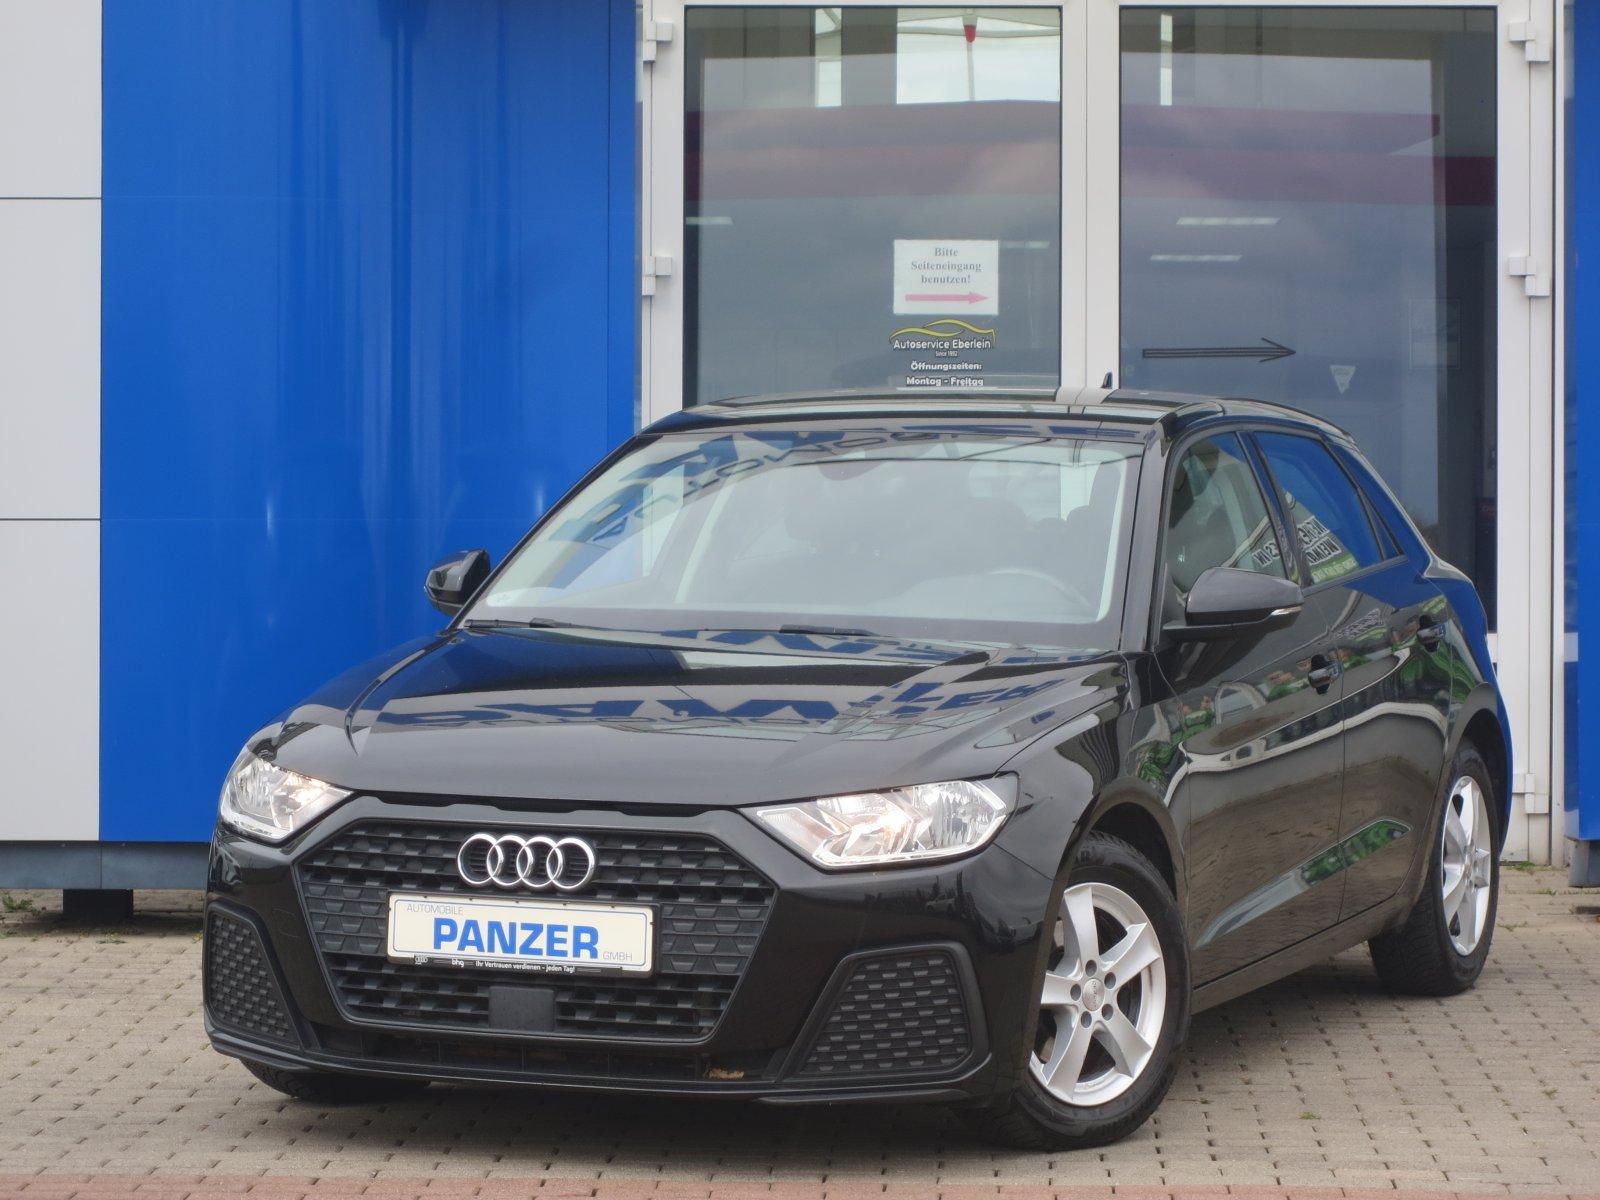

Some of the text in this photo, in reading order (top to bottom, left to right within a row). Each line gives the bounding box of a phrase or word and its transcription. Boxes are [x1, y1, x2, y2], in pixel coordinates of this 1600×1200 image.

[934, 247, 959, 257] Bitte
[911, 260, 983, 272] Seiteneingang
[921, 274, 971, 284] benutzen!
[893, 338, 991, 349] Autoservice Eberlein
[910, 360, 982, 371] Öffnungszeiten:
[906, 376, 942, 386] Montag
[950, 376, 984, 386] Freitag
[406, 902, 464, 916] AUTOMOBILE
[433, 916, 599, 960] PANZER
[602, 951, 633, 963] GMBH
[451, 958, 465, 968] bhg
[484, 961, 513, 969] Vertrauen
[545, 965, 562, 973] jeden
[563, 965, 576, 973] Tag!
